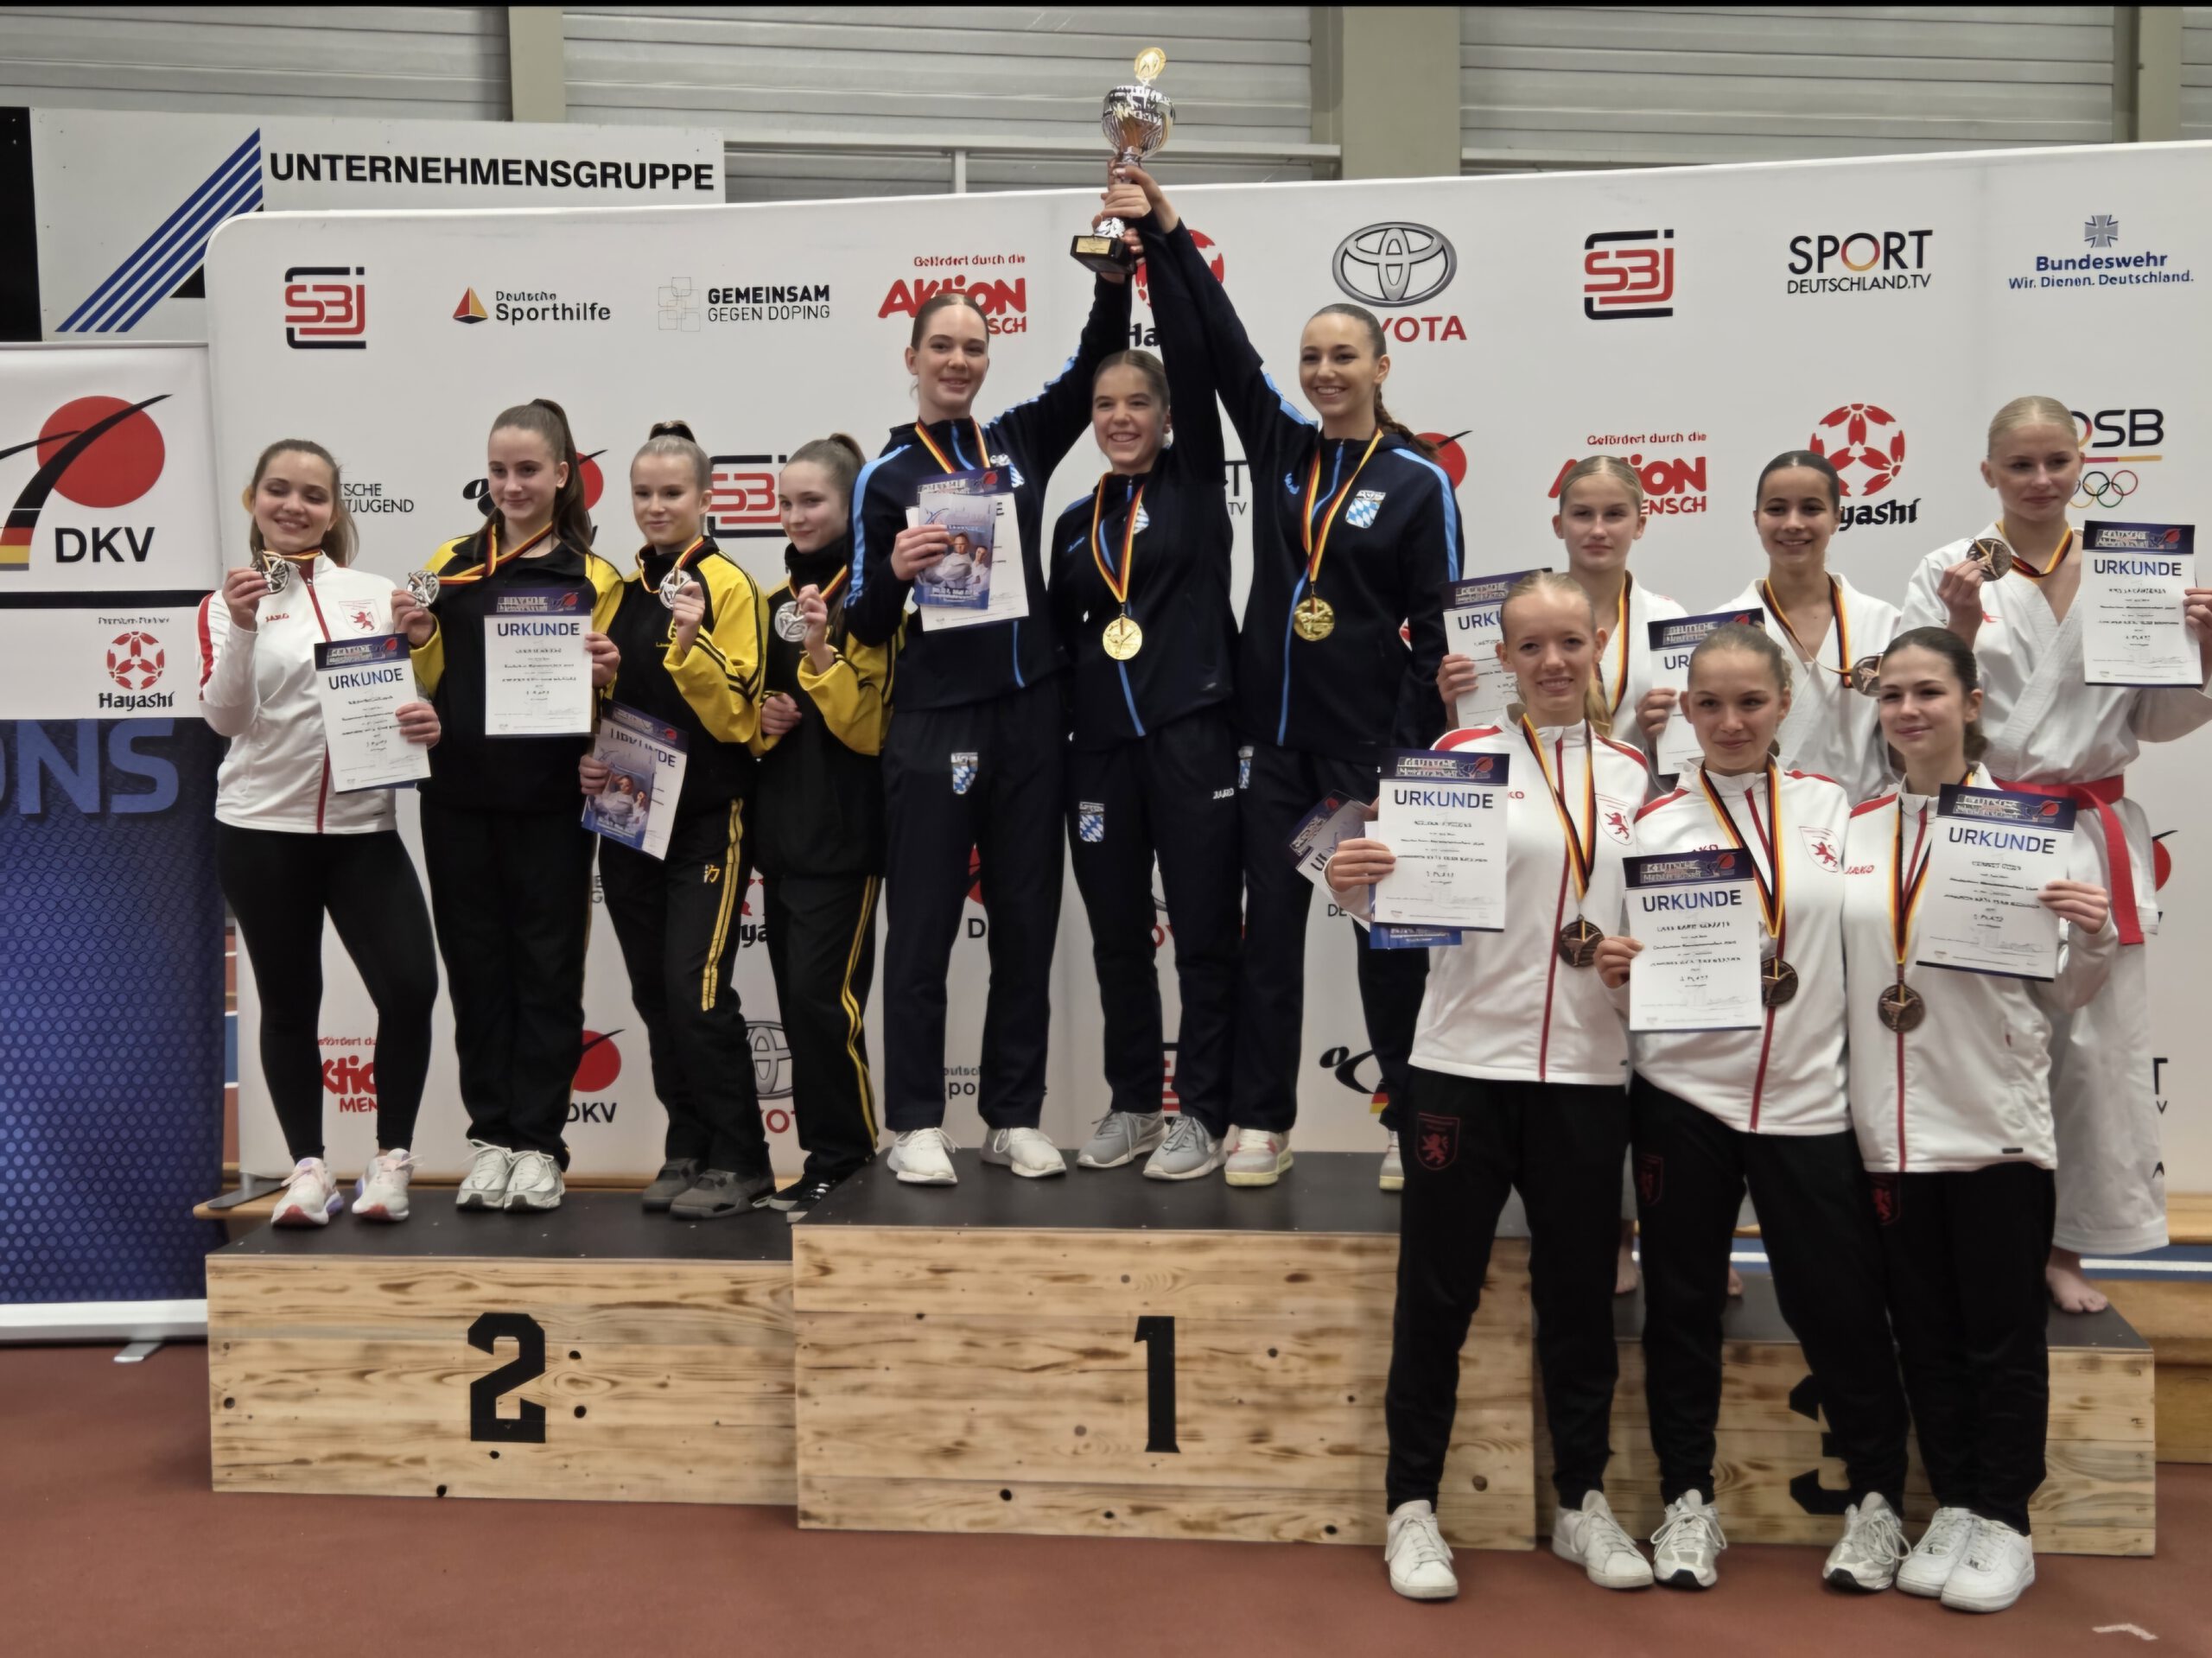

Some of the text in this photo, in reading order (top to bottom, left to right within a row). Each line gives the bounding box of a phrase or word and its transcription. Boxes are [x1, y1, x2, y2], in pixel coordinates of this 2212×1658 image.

[270, 153, 715, 192] UNTERNEHMENSGRUPPE
[1788, 230, 1933, 275] SPORT
[2036, 251, 2168, 271] Bundeswehr
[1787, 273, 1932, 295] DEUTSCHLAND.TV
[2009, 276, 2037, 289] Wir.
[2099, 270, 2194, 286] Deutschland.
[708, 284, 830, 304] GEMEINSAM
[496, 302, 611, 326] Sporthilfe
[709, 304, 830, 321] GEGEN DOPING
[988, 315, 1027, 335] SCH
[1382, 315, 1467, 343] OTA
[1649, 432, 1684, 443] durch
[342, 483, 382, 497] SCHE
[1640, 495, 1707, 516] ENSCH
[1838, 498, 1922, 531] yashi
[54, 526, 156, 563] DKV
[2094, 559, 2183, 576] URKUNDE
[497, 622, 581, 637] URKUNDE
[328, 668, 404, 690] URKUNDE
[99, 691, 175, 711] Hayashi
[0, 719, 180, 815] NS
[1394, 788, 1494, 810] URKUNDE
[1948, 826, 2056, 855] URKUNDE
[1643, 889, 1743, 912] URKUNDE
[340, 1096, 378, 1113] MEN
[467, 1312, 546, 1443] 2
[1134, 1315, 1181, 1454] 1
